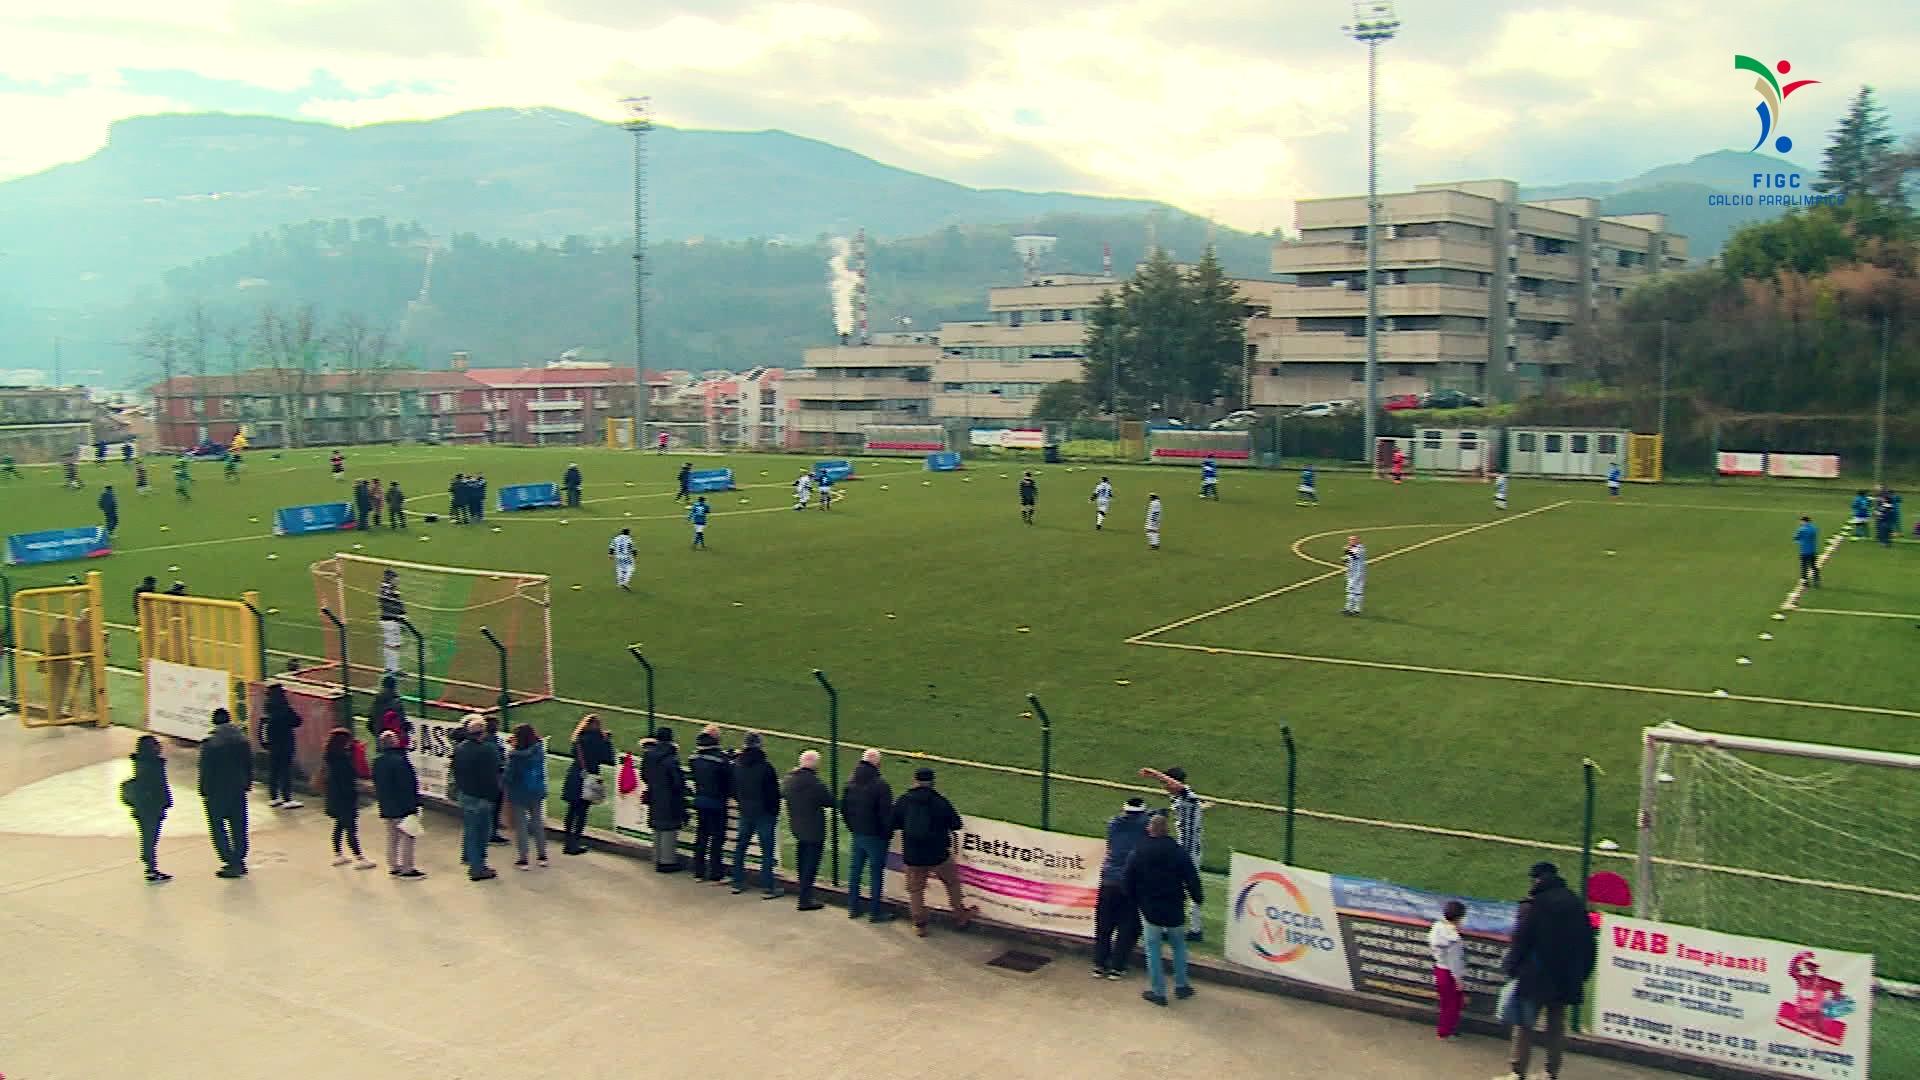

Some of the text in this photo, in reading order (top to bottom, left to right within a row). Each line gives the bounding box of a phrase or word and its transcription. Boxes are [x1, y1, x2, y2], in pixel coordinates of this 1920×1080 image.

[963, 832, 1087, 871] ElettroPaint
[1613, 925, 1769, 973] VAB Impianti
